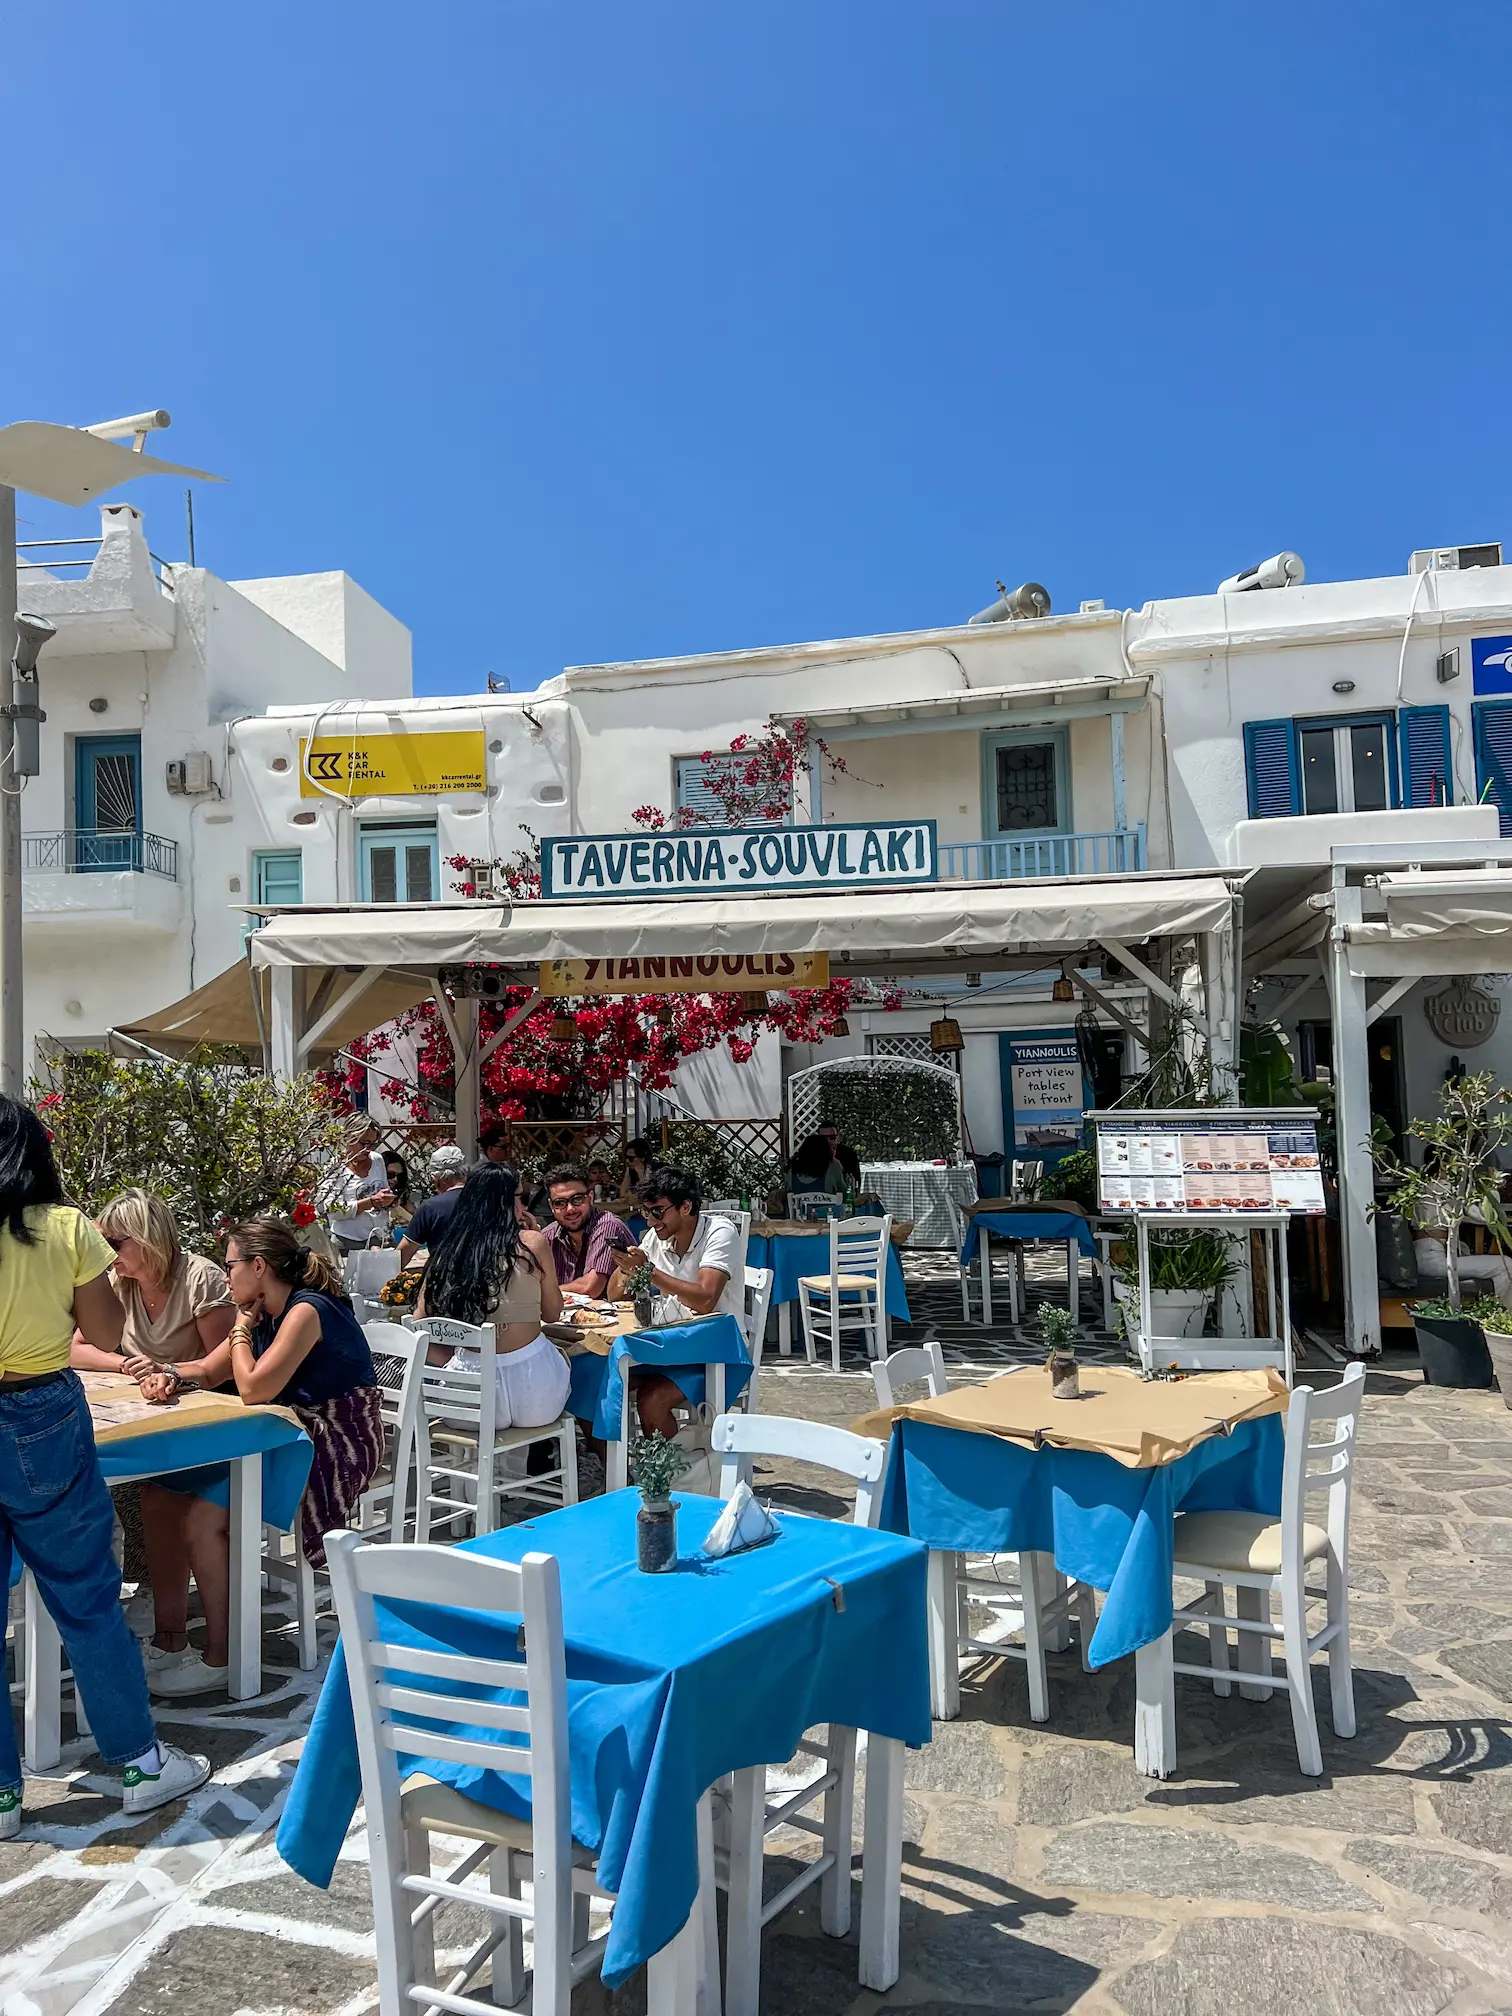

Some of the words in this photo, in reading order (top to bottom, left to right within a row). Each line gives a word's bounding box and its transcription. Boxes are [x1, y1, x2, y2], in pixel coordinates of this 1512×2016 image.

[347, 752, 369, 760] K&K
[347, 761, 369, 770] CAR
[348, 770, 386, 779] RENTAL
[441, 773, 482, 781] kkcarrental.gr
[557, 840, 726, 886] TAVERNA
[738, 829, 924, 879] SOUVLAKI
[1427, 997, 1501, 1016] Havana
[1443, 1014, 1486, 1034] Club
[1015, 1046, 1077, 1058] YIANNOULIS
[1018, 1067, 1042, 1078] Port
[1046, 1067, 1075, 1077] view
[1028, 1079, 1066, 1091] tables
[1023, 1095, 1036, 1105] in
[1040, 1092, 1073, 1105] front
